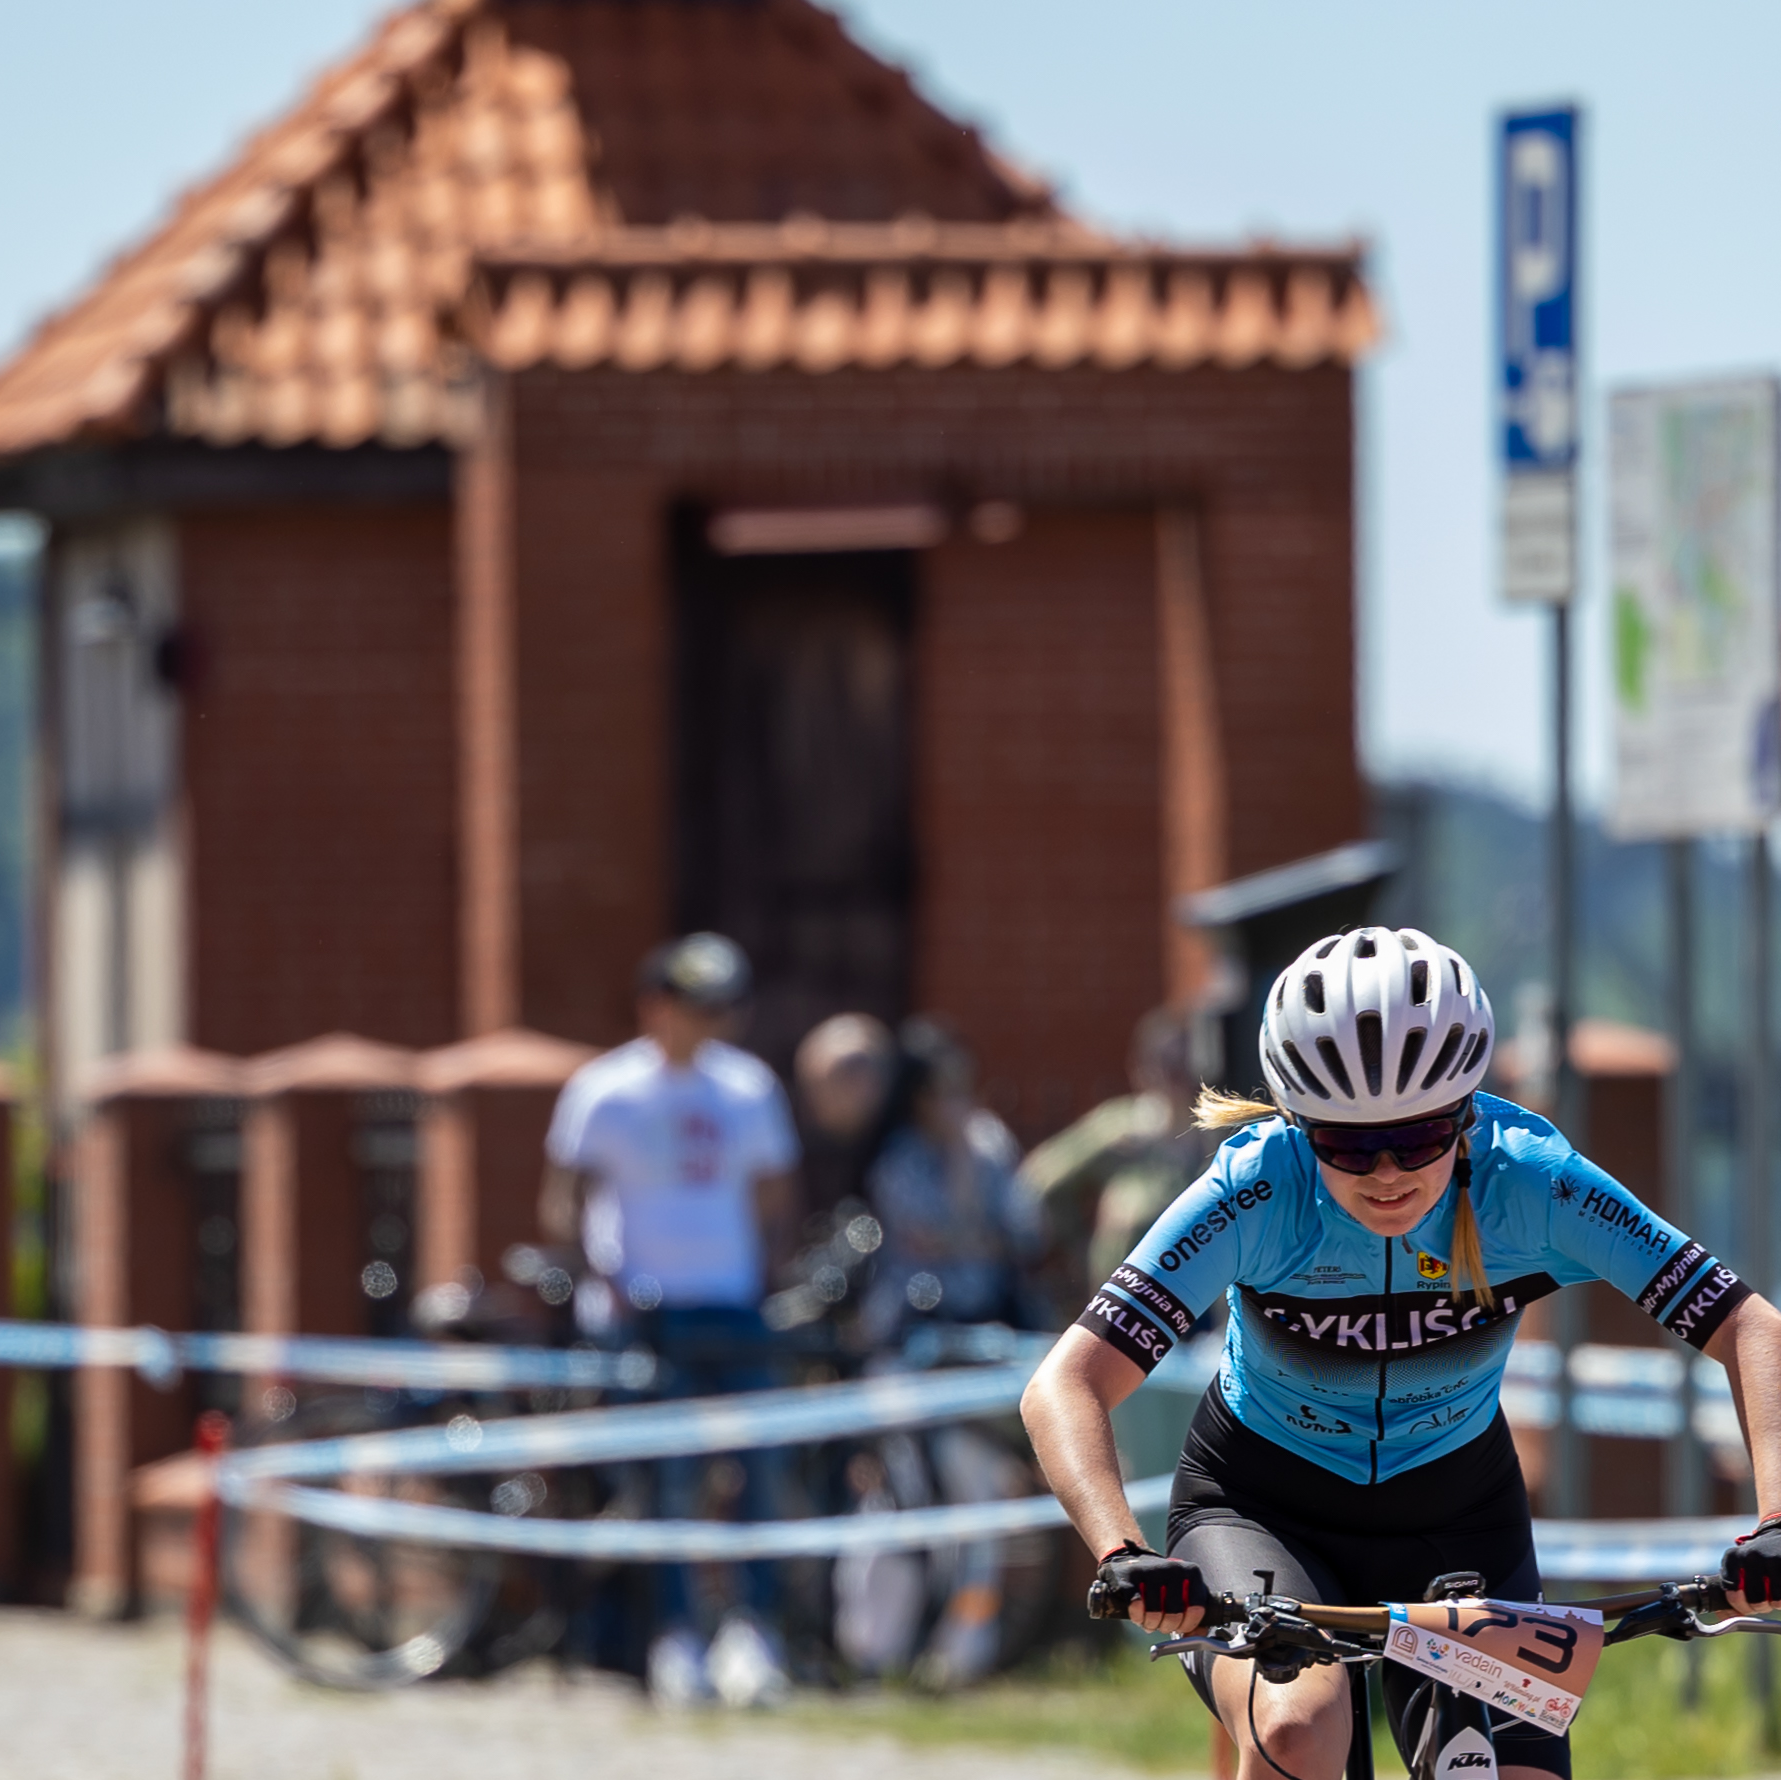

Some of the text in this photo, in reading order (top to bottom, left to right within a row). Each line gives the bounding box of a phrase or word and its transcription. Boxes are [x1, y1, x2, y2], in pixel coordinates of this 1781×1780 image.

[1581, 1187, 1673, 1253] KOMAR
[1578, 1210, 1662, 1262] MOSKITIERY
[1416, 1280, 1452, 1290] Rypin
[1443, 1579, 1479, 1589] SIGMA
[1447, 1752, 1492, 1771] KTM
